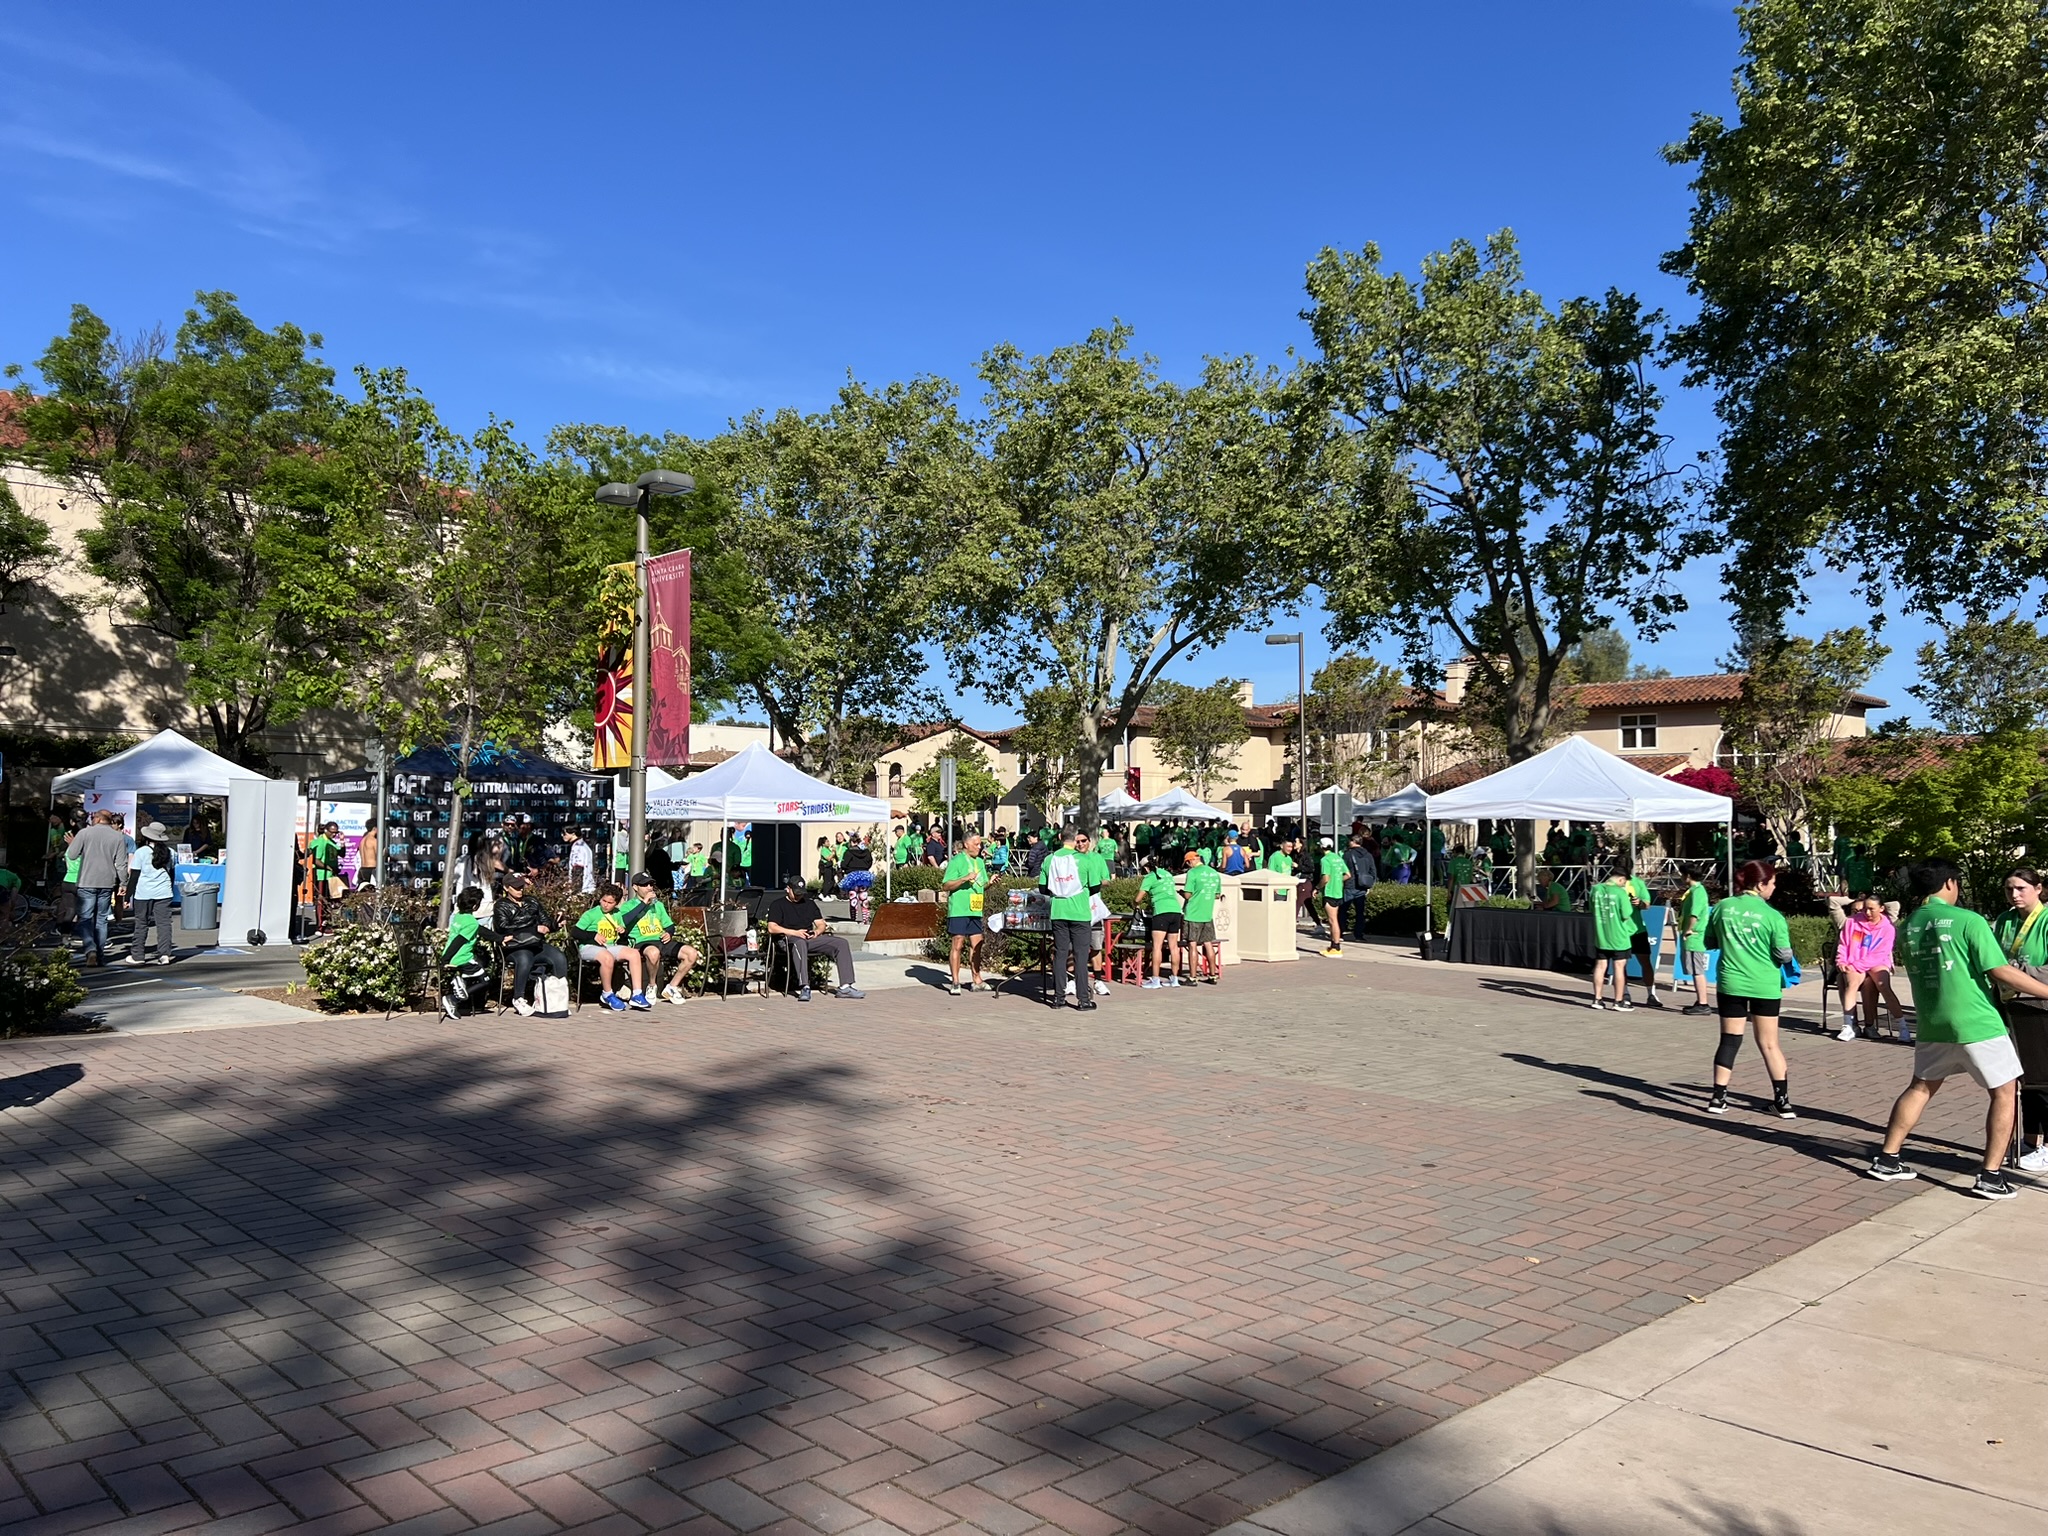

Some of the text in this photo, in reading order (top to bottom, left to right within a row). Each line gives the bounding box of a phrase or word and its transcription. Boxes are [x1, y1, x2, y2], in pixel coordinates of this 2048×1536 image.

[668, 563, 685, 572] CLARA
[651, 571, 685, 585] UNIVERSITY
[393, 774, 431, 795] BFT
[443, 781, 564, 795] BYFITTRAINING.COM
[576, 780, 607, 799] BFT
[653, 799, 698, 807] VALLEY HEALTH
[777, 801, 799, 814] STARS
[802, 803, 829, 816] STRIDES
[413, 810, 433, 822] BFT
[653, 808, 690, 816] FOUNDATION
[414, 877, 433, 889] BFT
